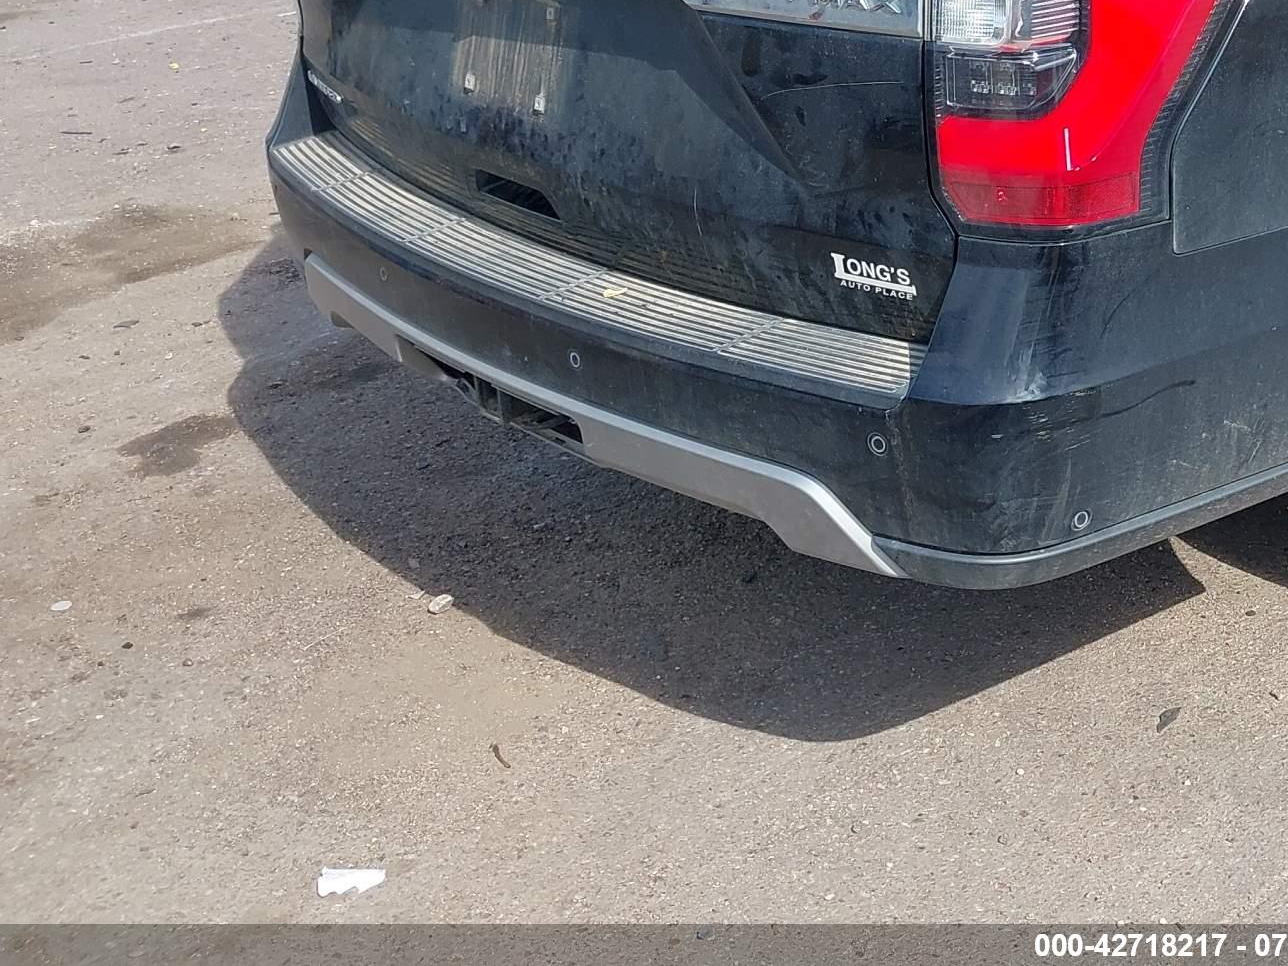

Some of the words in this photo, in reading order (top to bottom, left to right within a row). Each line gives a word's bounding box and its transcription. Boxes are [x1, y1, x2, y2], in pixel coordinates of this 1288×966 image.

[830, 252, 911, 285] LONG'S
[840, 279, 871, 292] AUTO
[875, 287, 913, 301] PLACE
